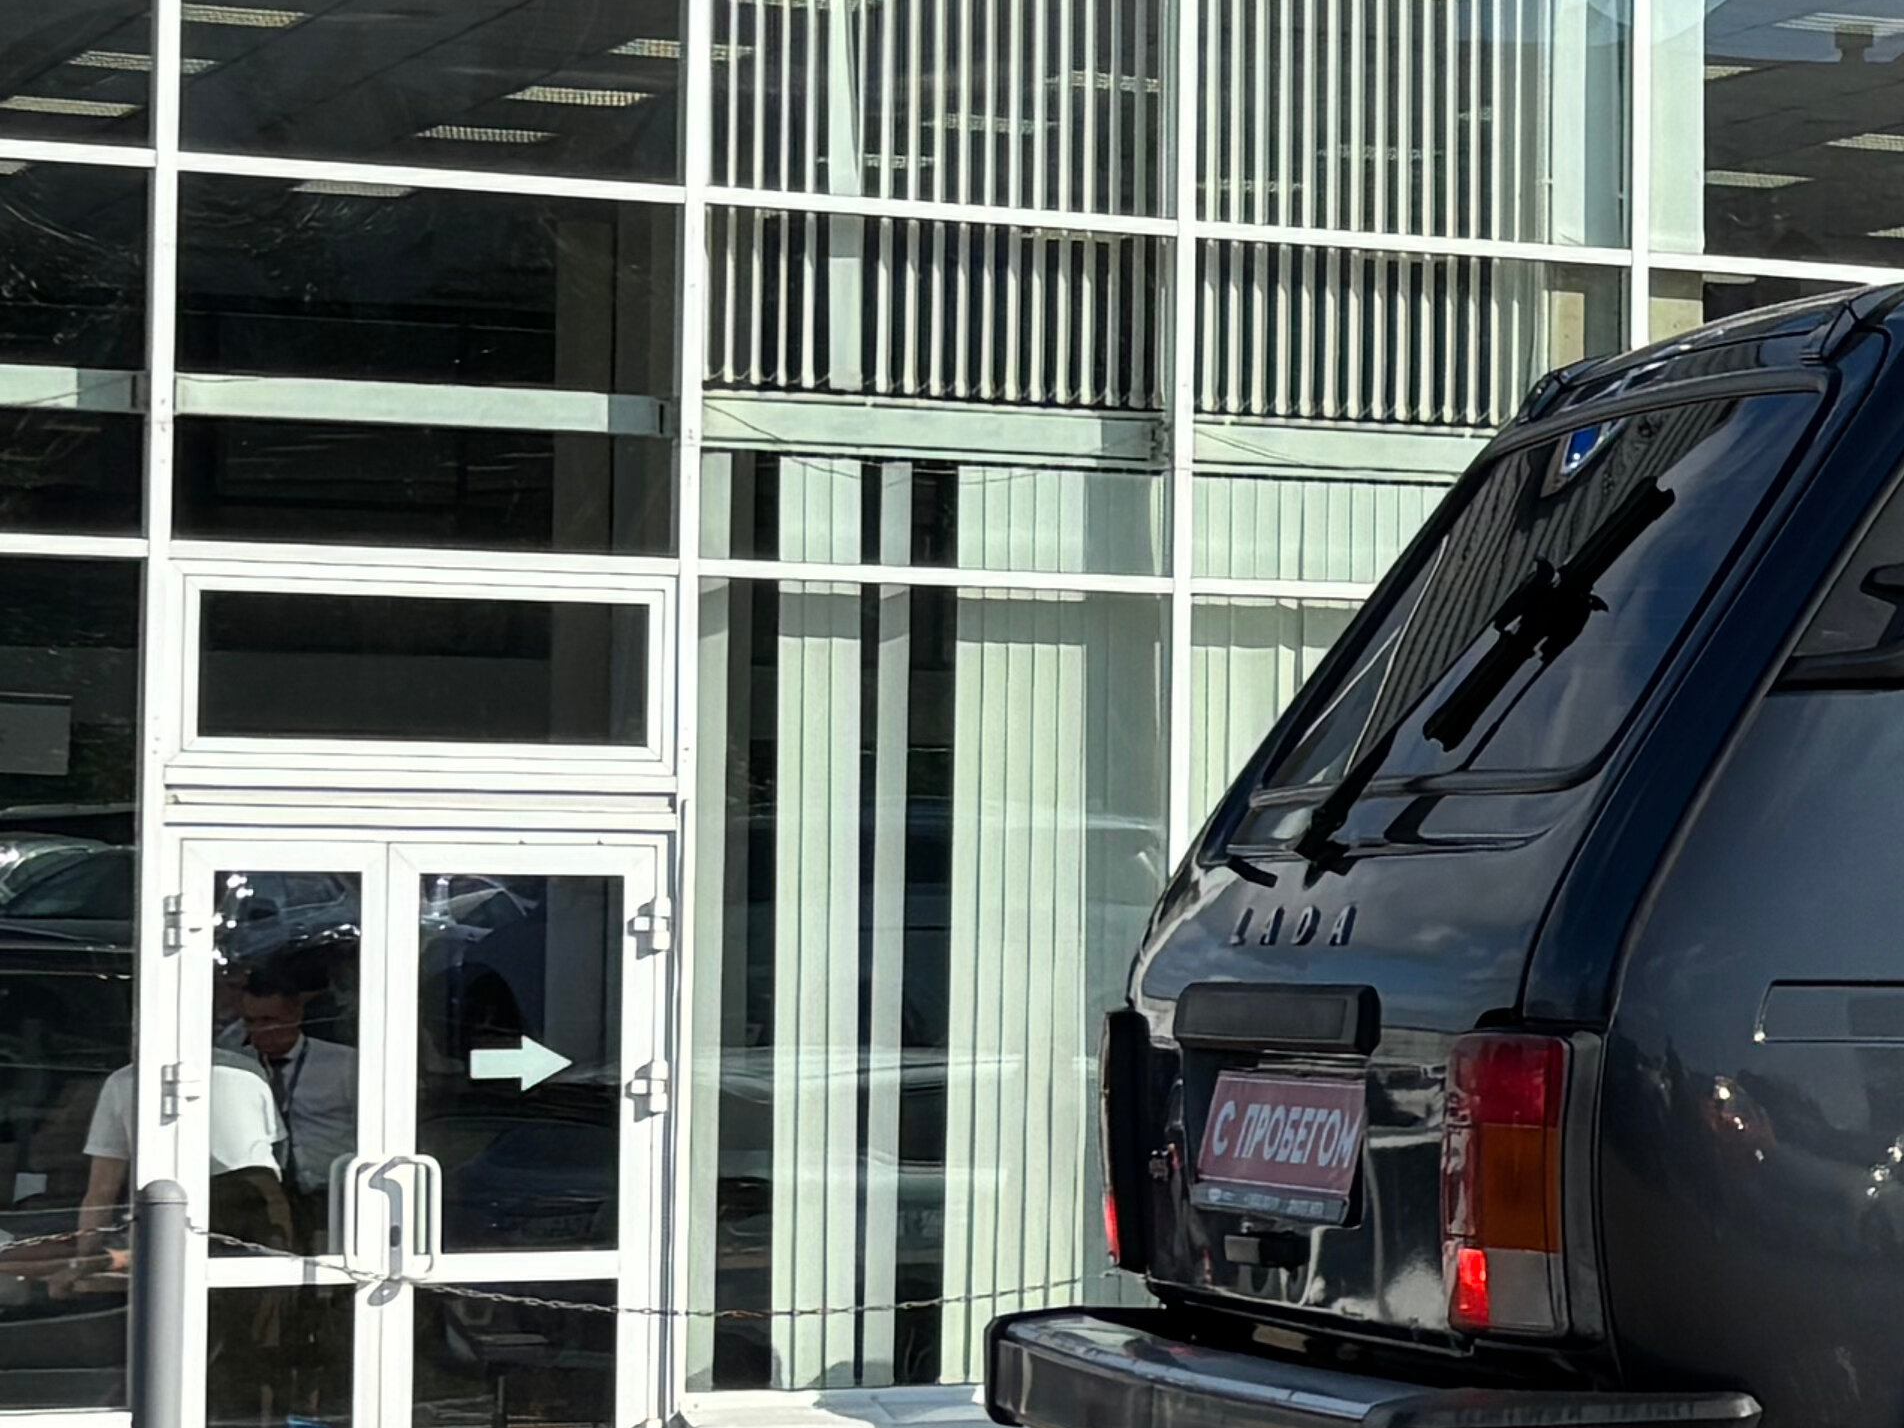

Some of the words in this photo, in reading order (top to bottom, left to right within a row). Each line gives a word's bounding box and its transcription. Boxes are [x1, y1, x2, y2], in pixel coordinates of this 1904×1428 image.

[1229, 904, 1358, 946] LADA
[1212, 1100, 1236, 1157] С
[1233, 1103, 1362, 1169] ПРОБЕГОМ
